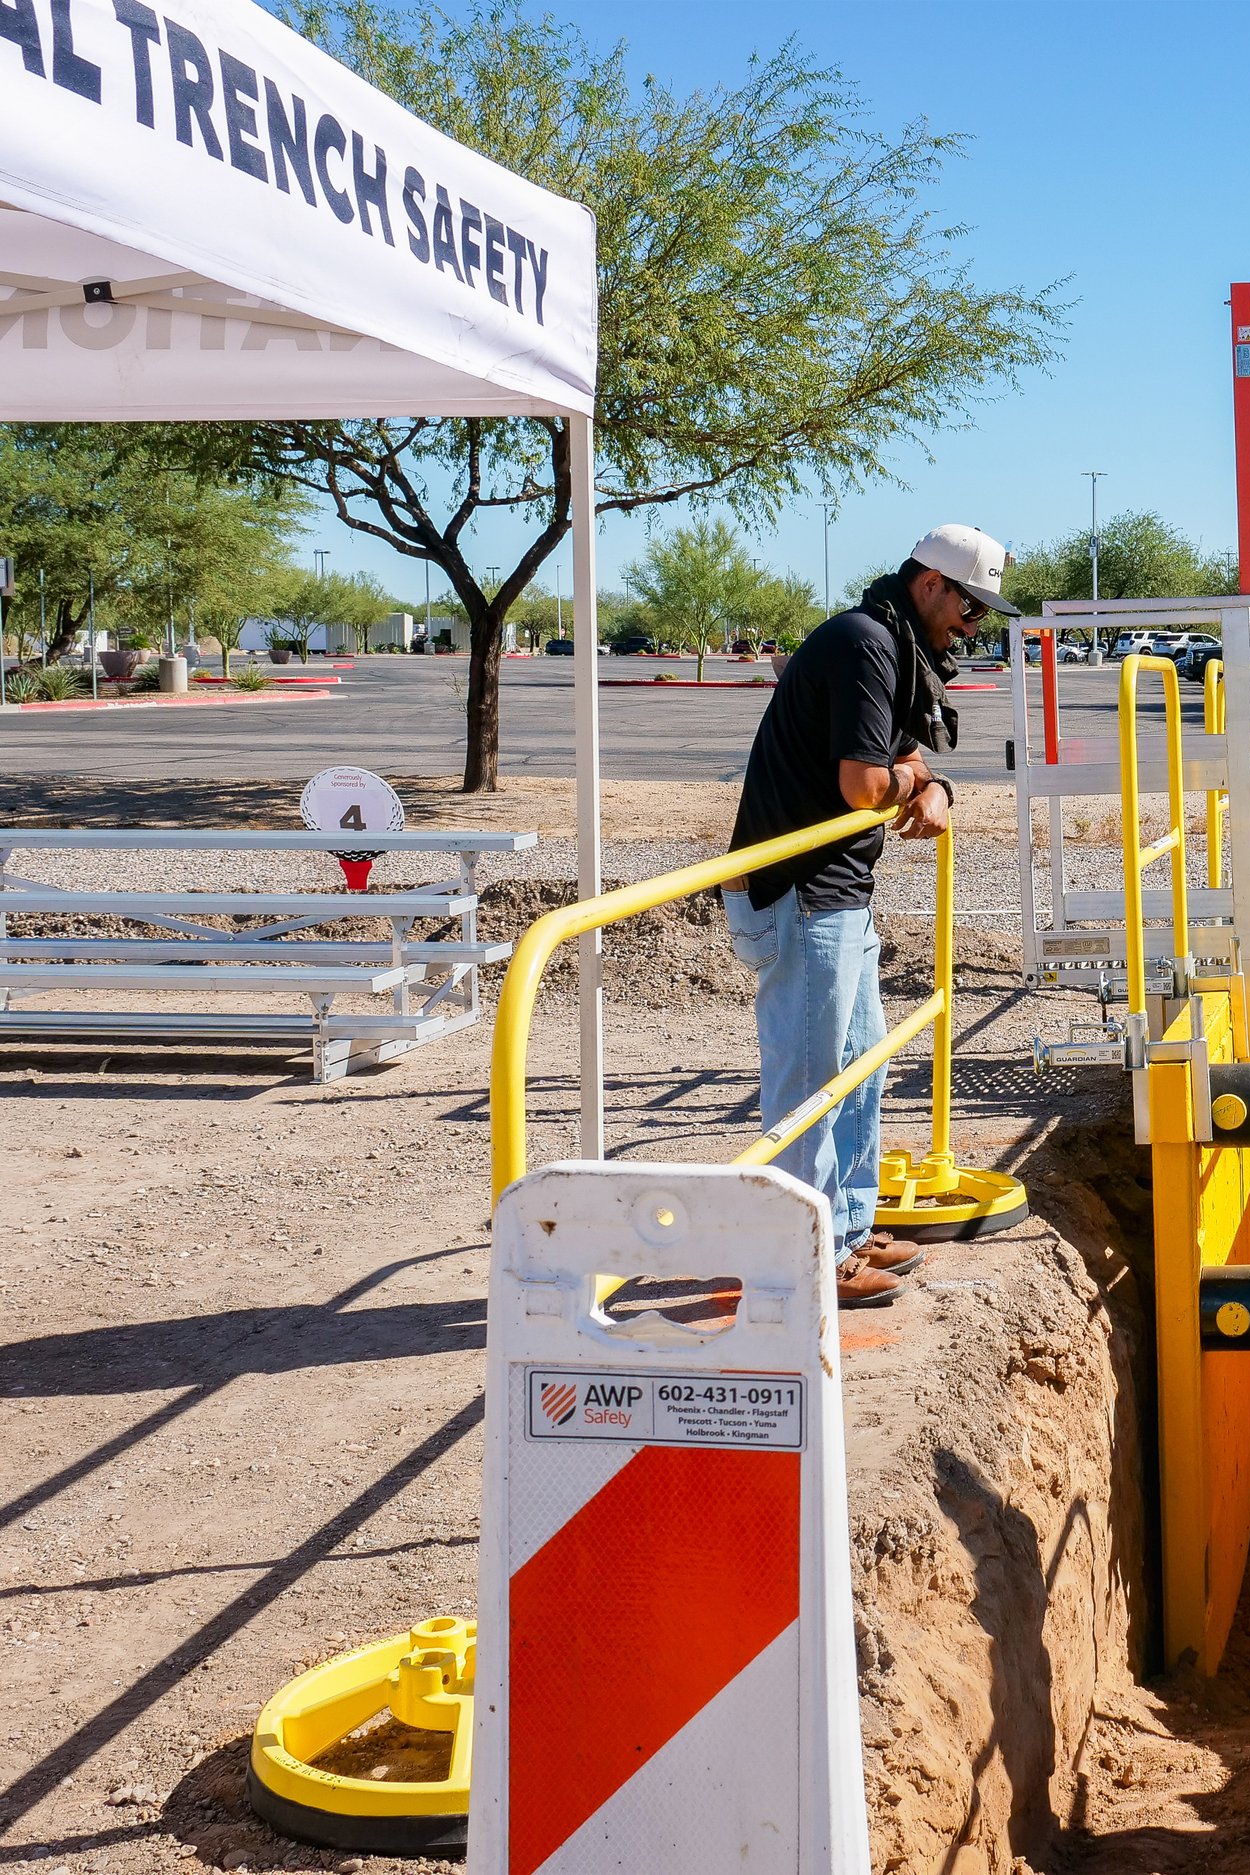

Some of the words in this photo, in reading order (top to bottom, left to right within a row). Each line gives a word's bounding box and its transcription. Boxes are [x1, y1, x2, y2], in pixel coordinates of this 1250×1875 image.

[115, 0, 395, 248] TRENCH
[402, 165, 549, 326] SAFETY
[359, 781, 367, 789] by
[340, 804, 367, 831] 4
[584, 1384, 643, 1408] AWP
[658, 1384, 795, 1406] 602-431-0911
[584, 1408, 632, 1428] Safety
[667, 1405, 702, 1415] Phoenix
[707, 1406, 746, 1416] Chandler
[752, 1408, 789, 1418] Flagstaff
[678, 1416, 713, 1426] Prescott
[718, 1418, 748, 1428] Tucson
[754, 1420, 777, 1429] Yuma
[686, 1428, 725, 1438] Holbrook
[732, 1430, 770, 1440] Kingman
